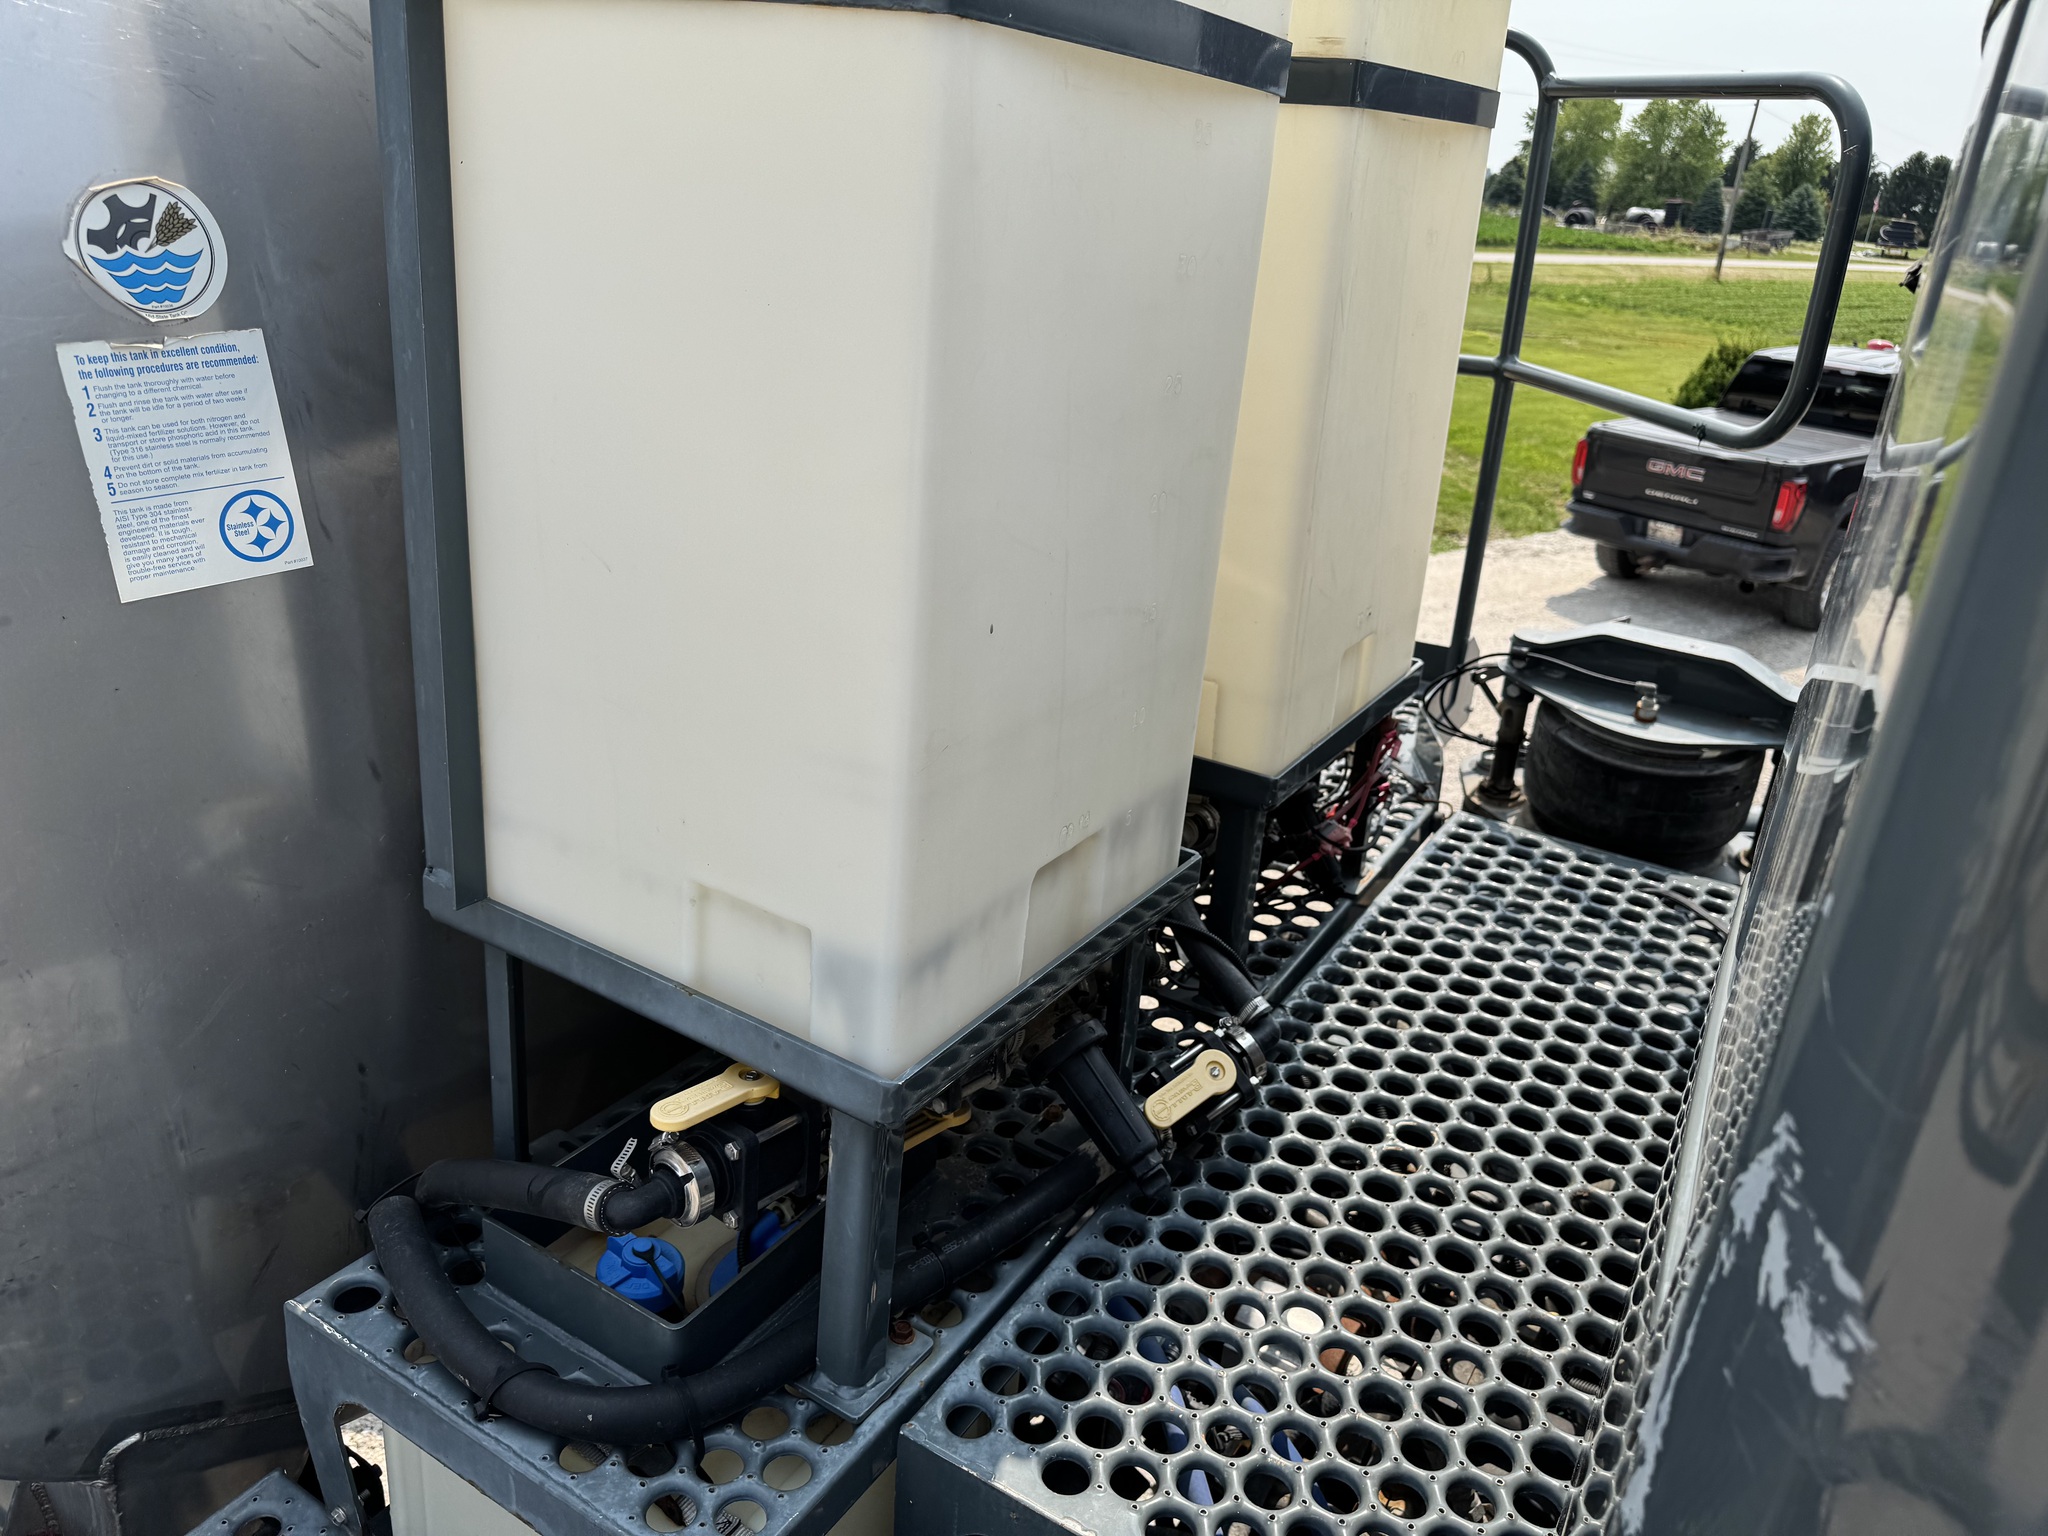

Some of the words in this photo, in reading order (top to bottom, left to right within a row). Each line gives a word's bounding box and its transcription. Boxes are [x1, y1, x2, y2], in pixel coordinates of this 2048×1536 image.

[74, 355, 86, 366] To
[87, 354, 109, 365] keep
[110, 352, 128, 362] this
[130, 350, 149, 360] tank
[150, 349, 158, 359] in
[161, 346, 199, 358] excellent
[200, 343, 240, 354] condition,
[78, 370, 92, 380] the
[94, 366, 135, 378] following
[136, 362, 184, 376] procedures
[186, 361, 199, 370] are
[201, 354, 259, 368] recommended:
[93, 384, 112, 392] Flush
[114, 382, 125, 390] the
[143, 378, 179, 387] thoroughly
[1164, 372, 1183, 394] 25
[82, 386, 90, 400] 1
[95, 390, 127, 399] changing
[144, 386, 171, 395] different
[87, 403, 96, 417] 2
[98, 402, 117, 410] Flush
[183, 400, 203, 409] period
[191, 417, 205, 425] both
[93, 428, 102, 442] 3
[106, 432, 147, 442] liquid-mixed
[149, 429, 175, 437] fertilizer
[108, 440, 140, 449] transport
[167, 432, 204, 443] phosphoric
[205, 428, 218, 436] acid
[110, 449, 129, 457] (Type
[145, 442, 174, 451] stainless
[199, 436, 226, 444] normally
[228, 430, 270, 440] recommended
[114, 464, 140, 472] Prevent
[180, 455, 210, 464] materials
[227, 447, 268, 457] accumulating
[104, 466, 112, 479] 4
[1646, 458, 1706, 482] GMC
[161, 473, 191, 482] complete
[107, 482, 116, 496] 5
[119, 487, 144, 495] season
[174, 500, 188, 508] from
[1150, 491, 1169, 514] 20
[132, 514, 147, 522] Type
[164, 507, 192, 515] stainless
[171, 513, 189, 521] finest
[118, 526, 158, 536] engineering
[159, 521, 189, 529] materials
[227, 521, 254, 531] Stainless
[234, 529, 250, 537] Steel
[122, 540, 150, 549] resistant
[160, 532, 197, 543] mechanical
[123, 548, 150, 556] damage
[132, 553, 152, 562] easily
[153, 549, 179, 558] cleaned
[176, 554, 194, 562] years
[128, 566, 166, 576] trouble-free
[129, 573, 151, 582] proper
